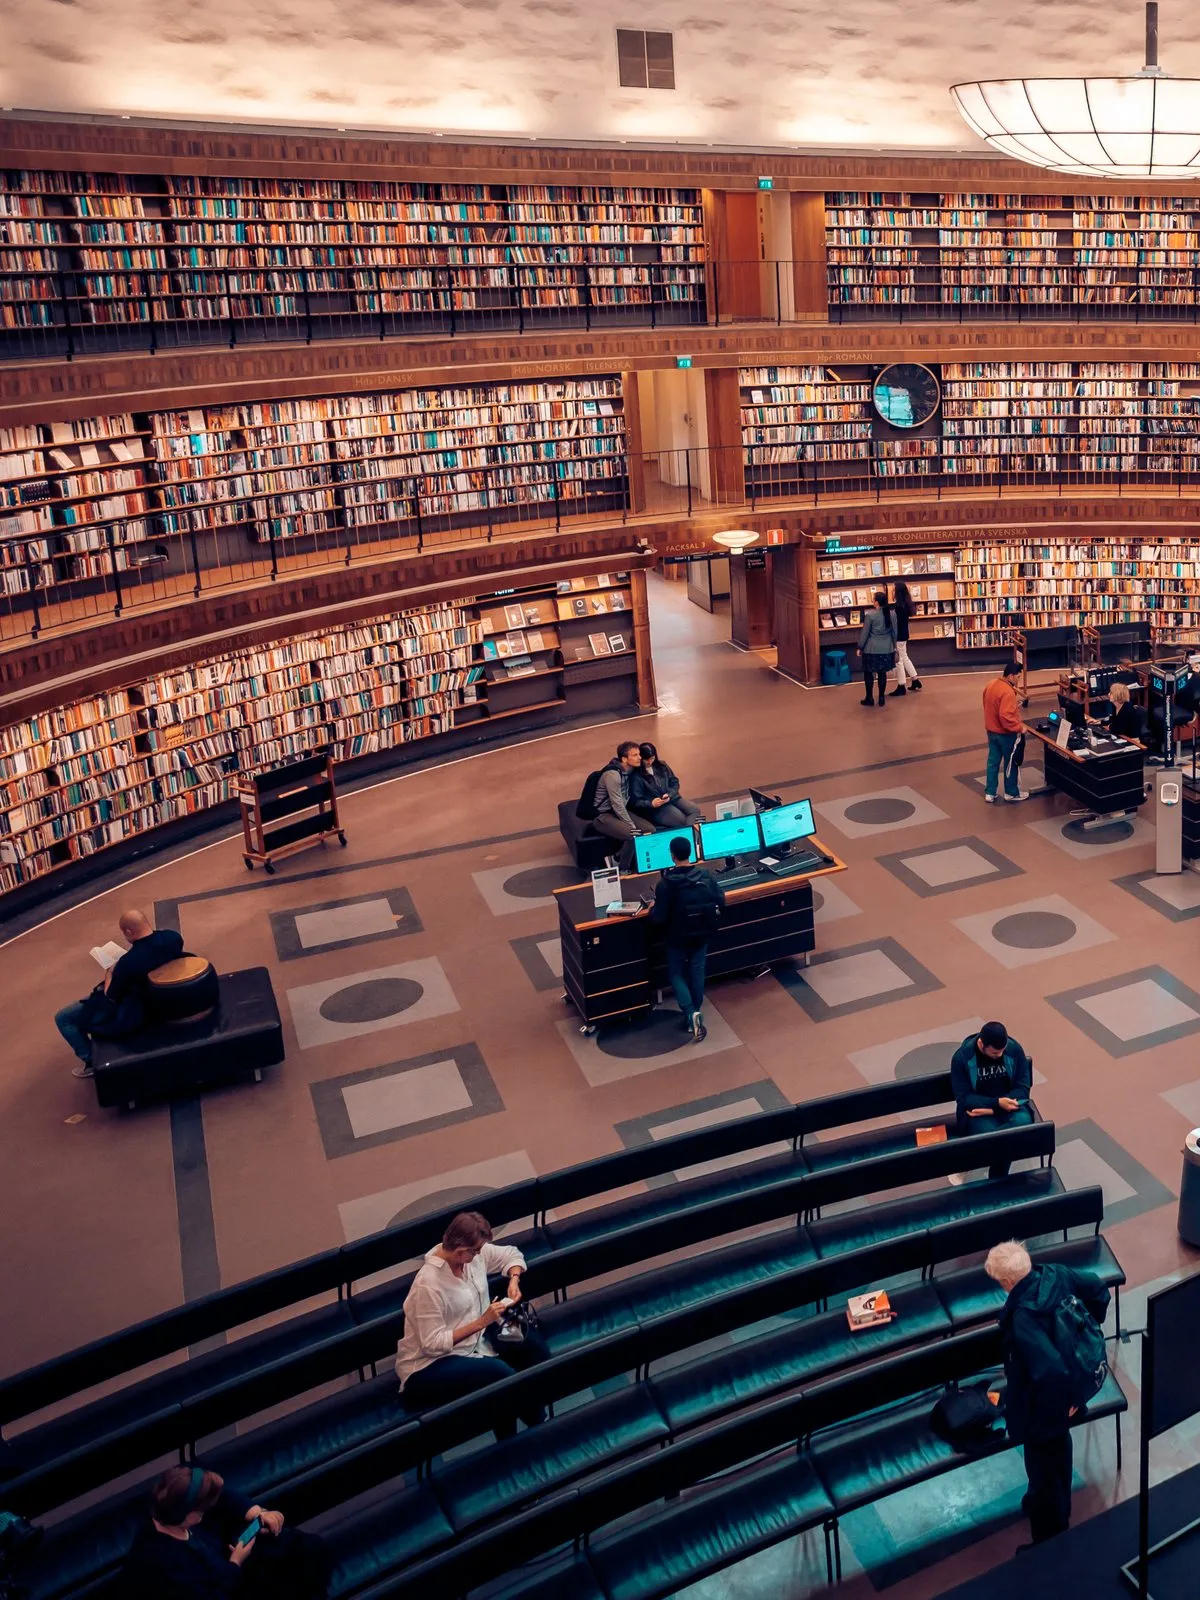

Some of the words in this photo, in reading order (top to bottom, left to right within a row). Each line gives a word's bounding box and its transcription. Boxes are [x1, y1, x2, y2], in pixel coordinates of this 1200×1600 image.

[836, 353, 873, 361] ROMANI
[536, 362, 572, 373] NORSK
[378, 374, 415, 385] DANSK
[891, 531, 971, 541] SKÖNLITTERATUR
[988, 528, 1028, 537] SVENSKA
[665, 543, 700, 552] FACKSAL
